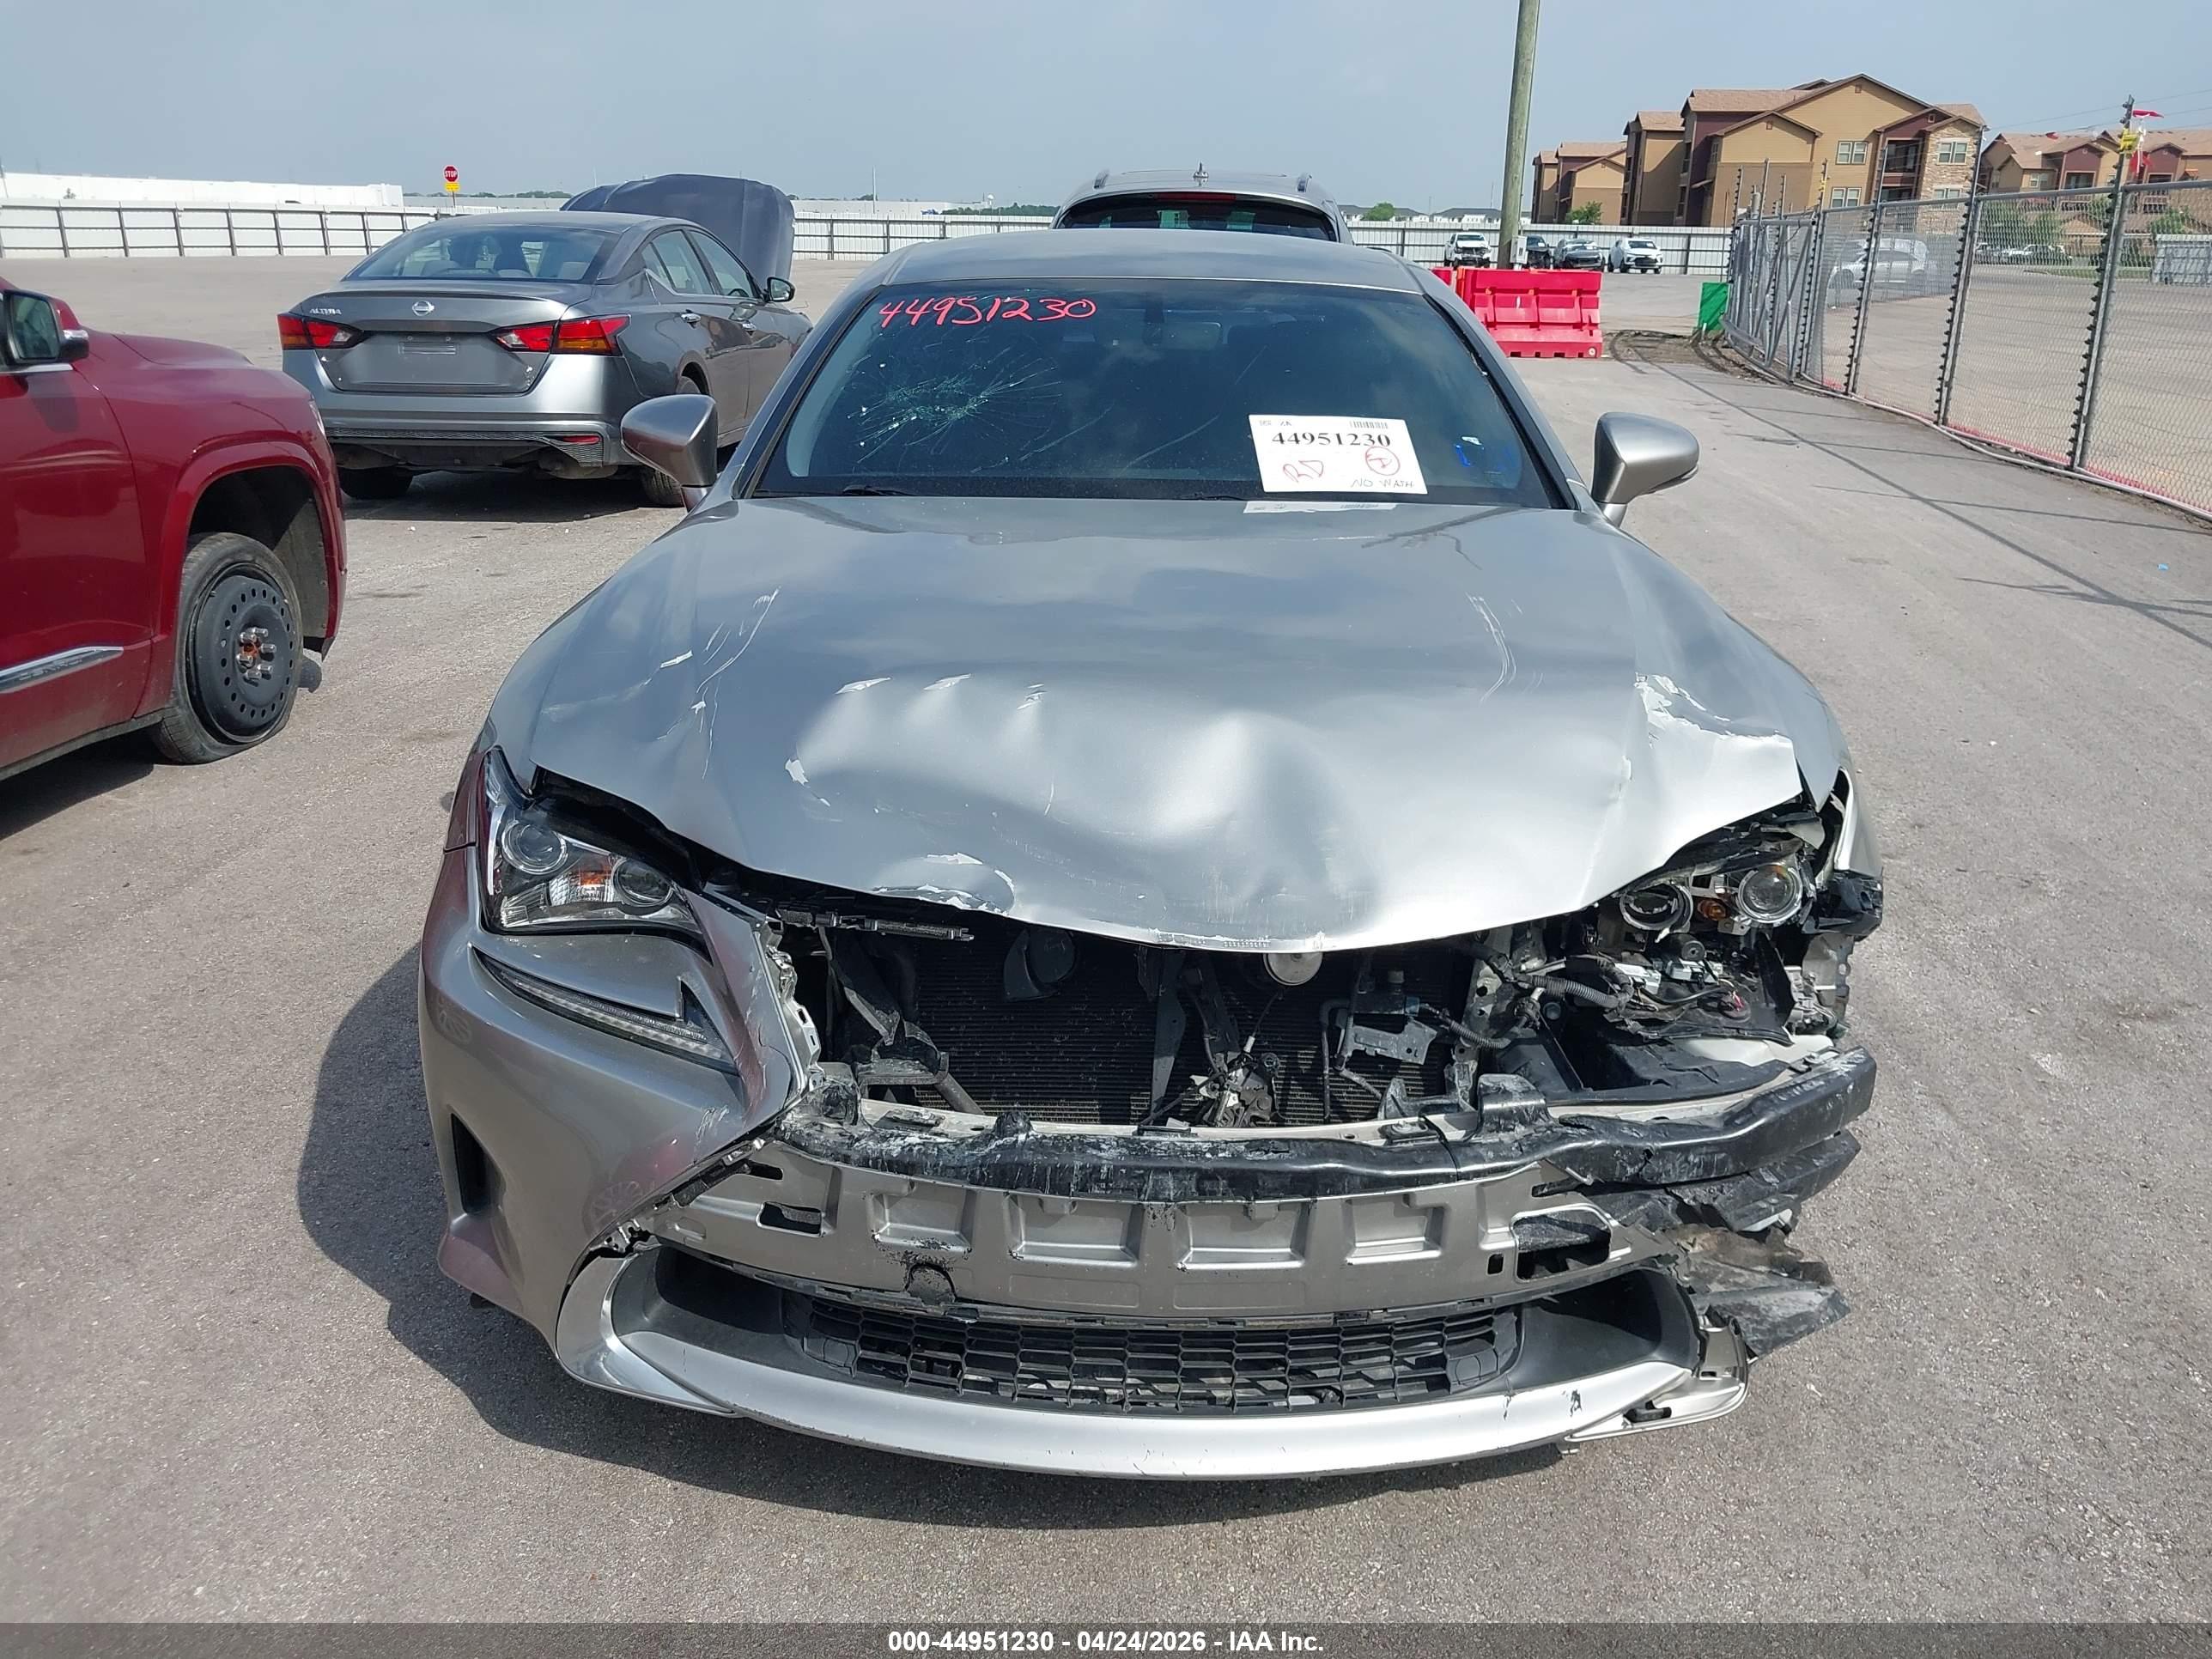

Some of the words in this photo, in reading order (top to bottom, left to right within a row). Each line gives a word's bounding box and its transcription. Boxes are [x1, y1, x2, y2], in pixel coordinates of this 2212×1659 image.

[878, 297, 1097, 328] 44951230
[1272, 432, 1391, 447] 44951230
[1350, 477, 1374, 488] NO
